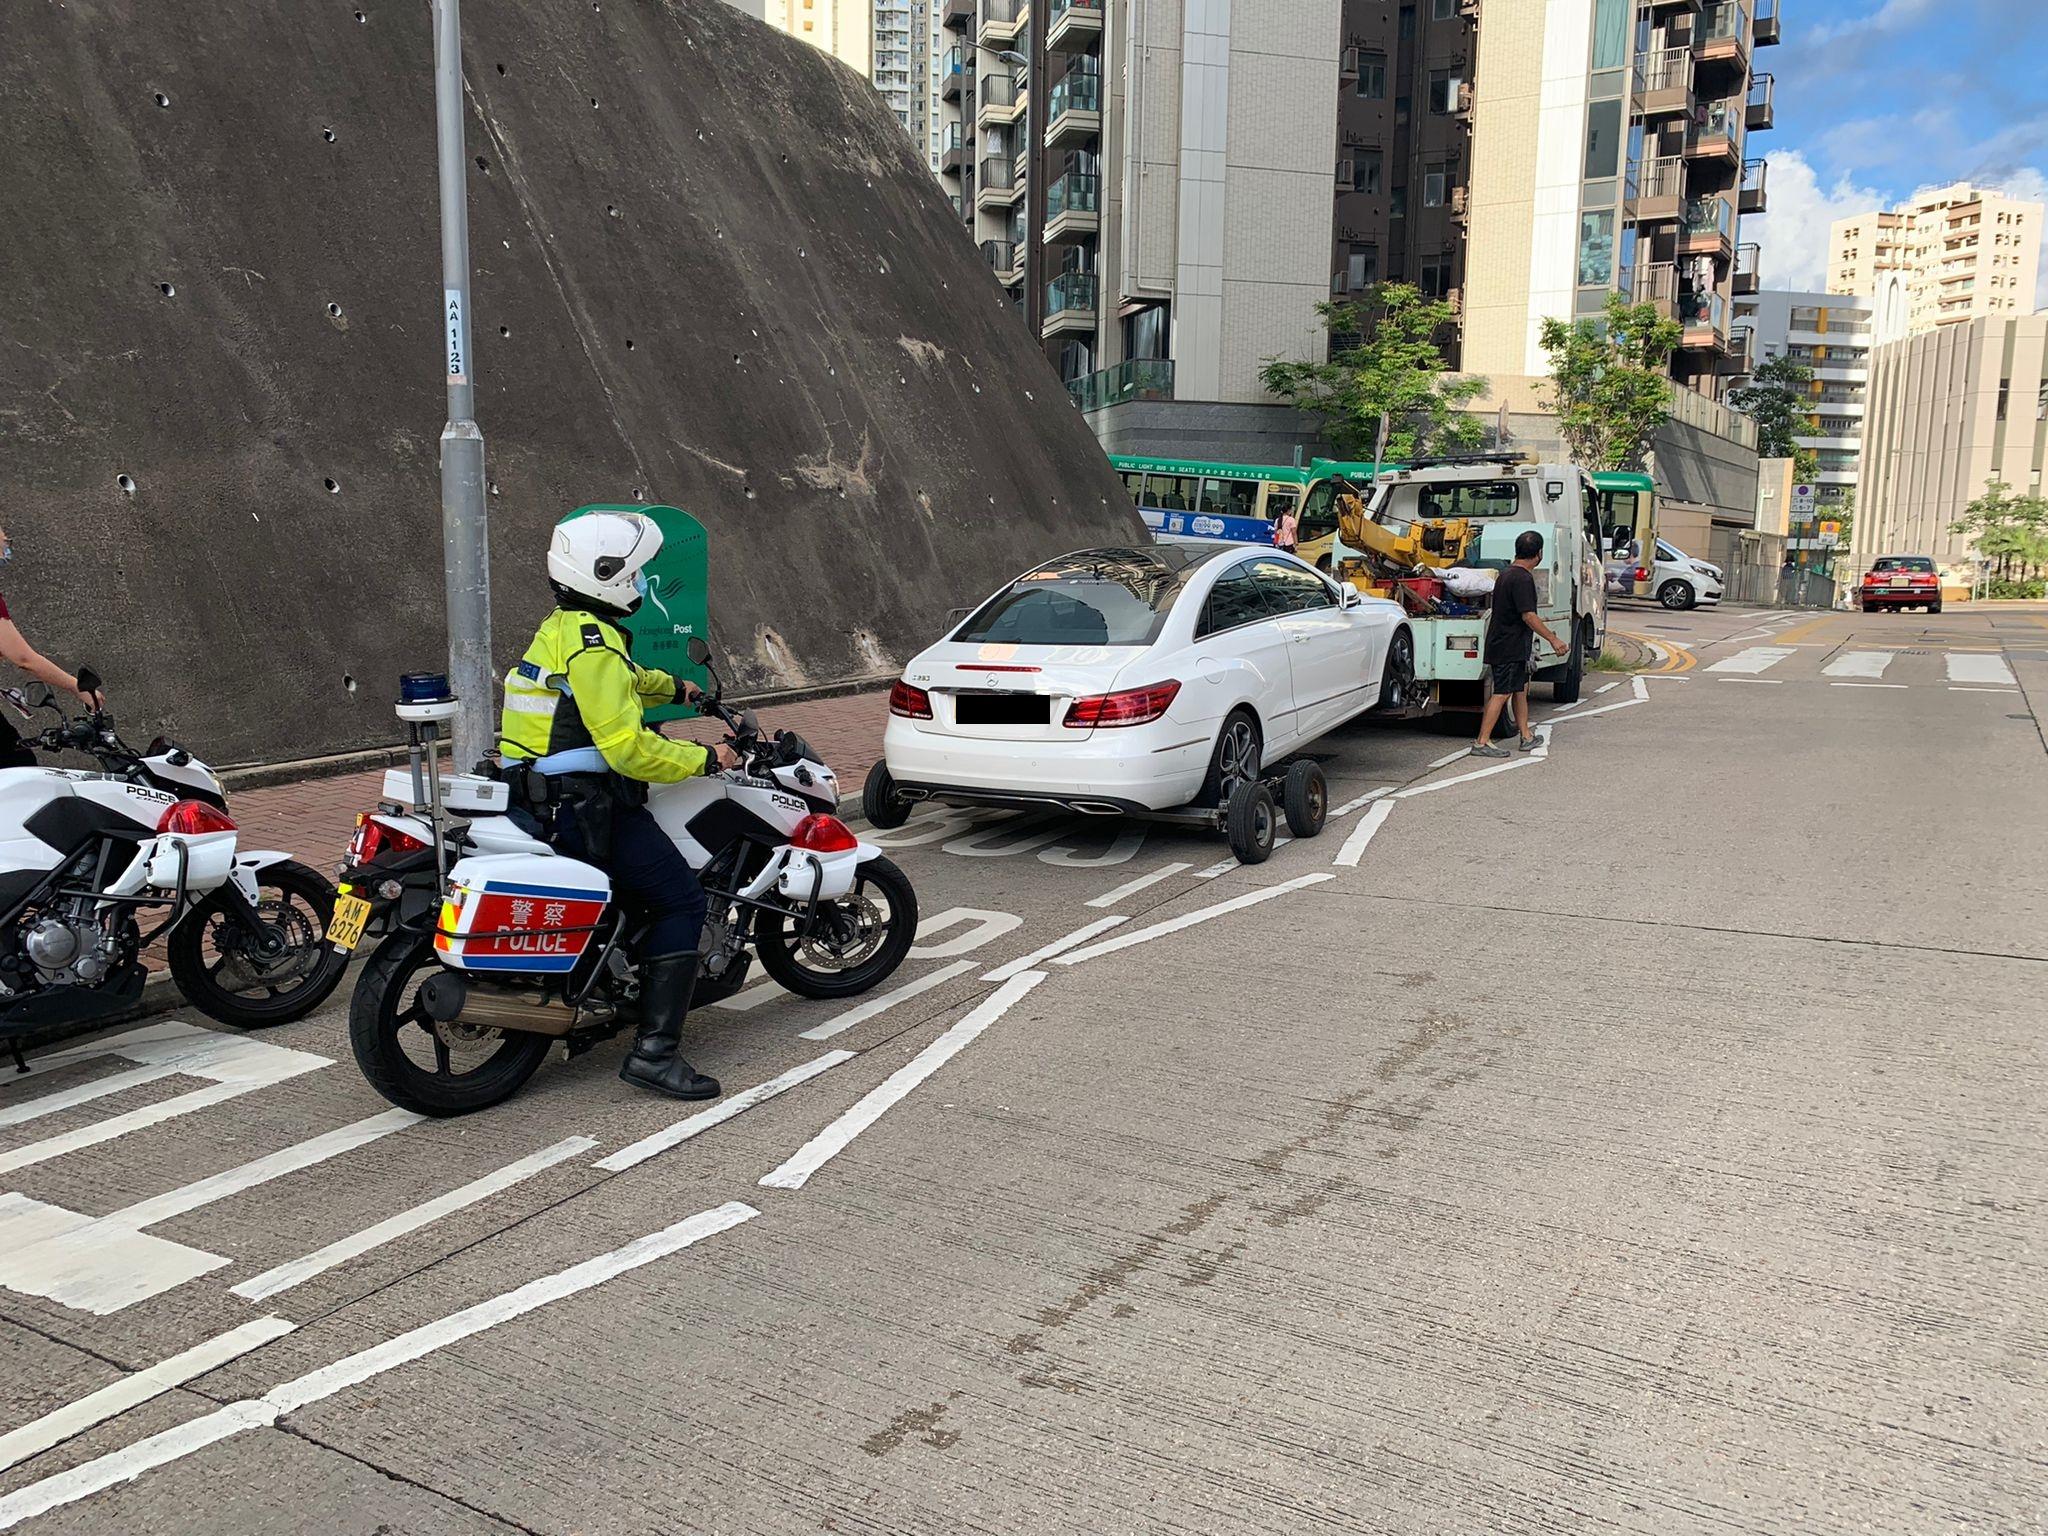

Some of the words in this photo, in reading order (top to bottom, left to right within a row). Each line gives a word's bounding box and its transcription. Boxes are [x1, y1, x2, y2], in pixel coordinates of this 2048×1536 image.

[1118, 461, 1135, 469] PUBLIC
[1138, 462, 1153, 470] LIGHT
[1350, 471, 1373, 479] PUBLIC
[673, 624, 692, 634] Post
[126, 785, 176, 803] POLICE
[771, 793, 806, 811] POLICE
[342, 900, 364, 922] AM
[509, 899, 567, 926] 警察
[329, 917, 360, 944] 6276
[493, 925, 567, 953] POLICE
